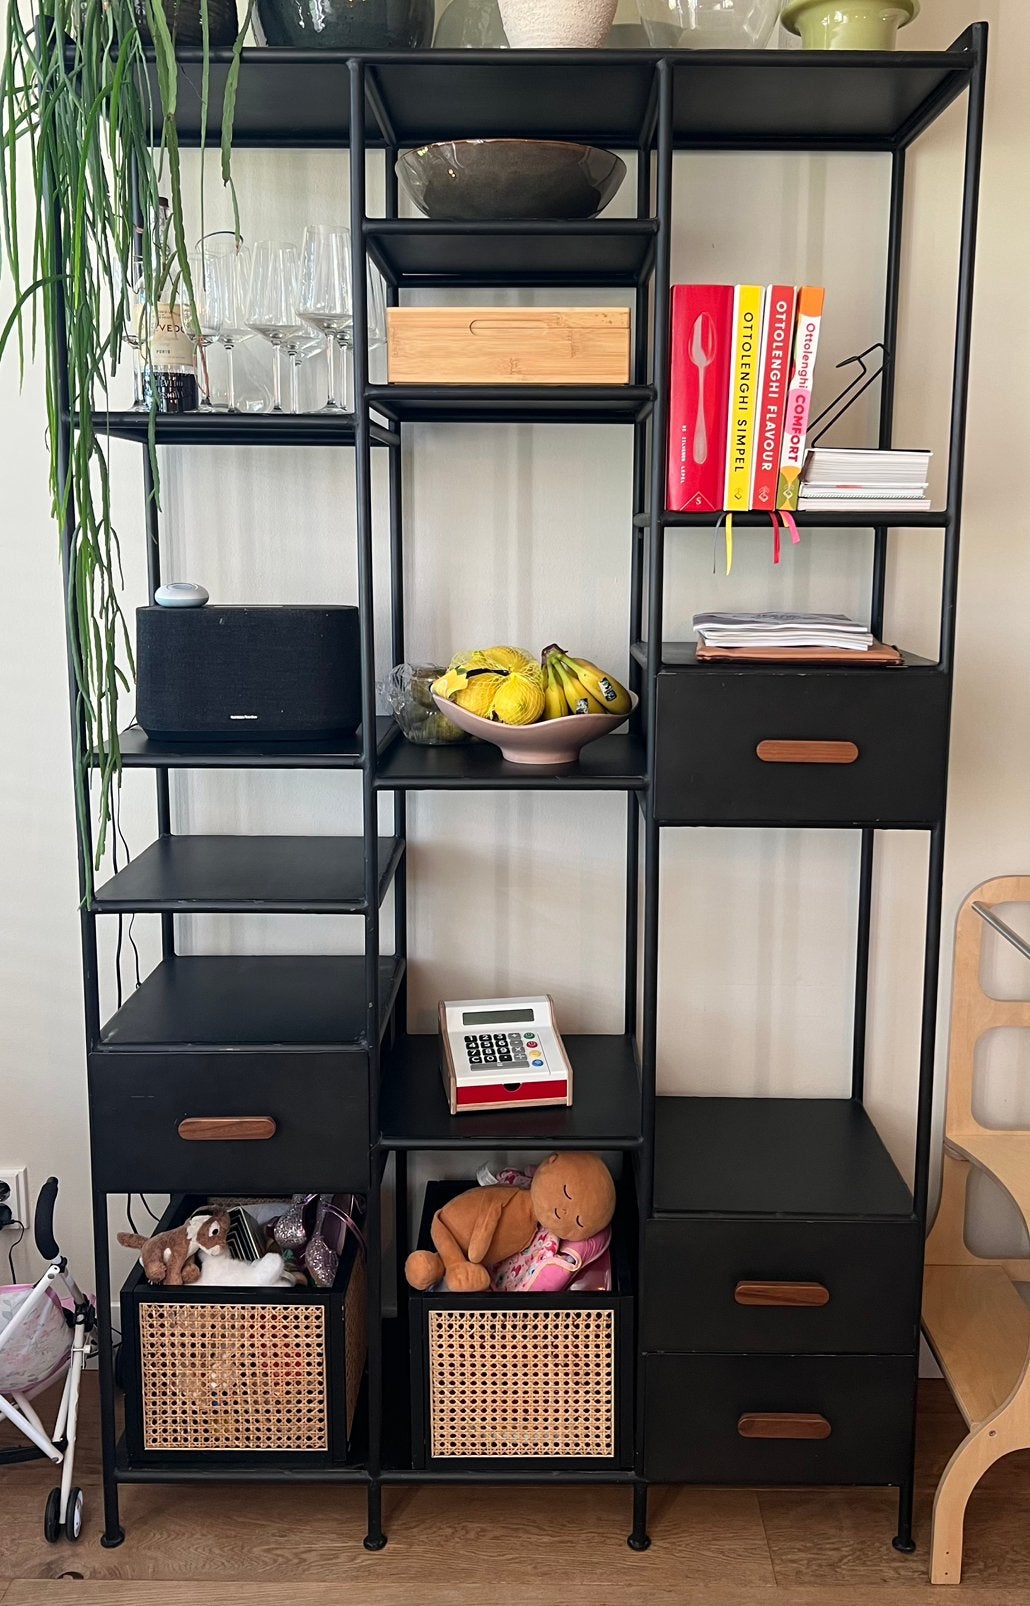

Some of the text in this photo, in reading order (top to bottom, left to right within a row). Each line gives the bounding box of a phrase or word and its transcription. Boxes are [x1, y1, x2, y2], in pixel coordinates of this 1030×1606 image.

[735, 312, 753, 472] OTTOLENGHI SIMPEL
[762, 301, 787, 471] OTTOLENGHI FLAVOUR
[788, 323, 815, 462] Ottolenghi COMFORT
[695, 496, 702, 506] S
